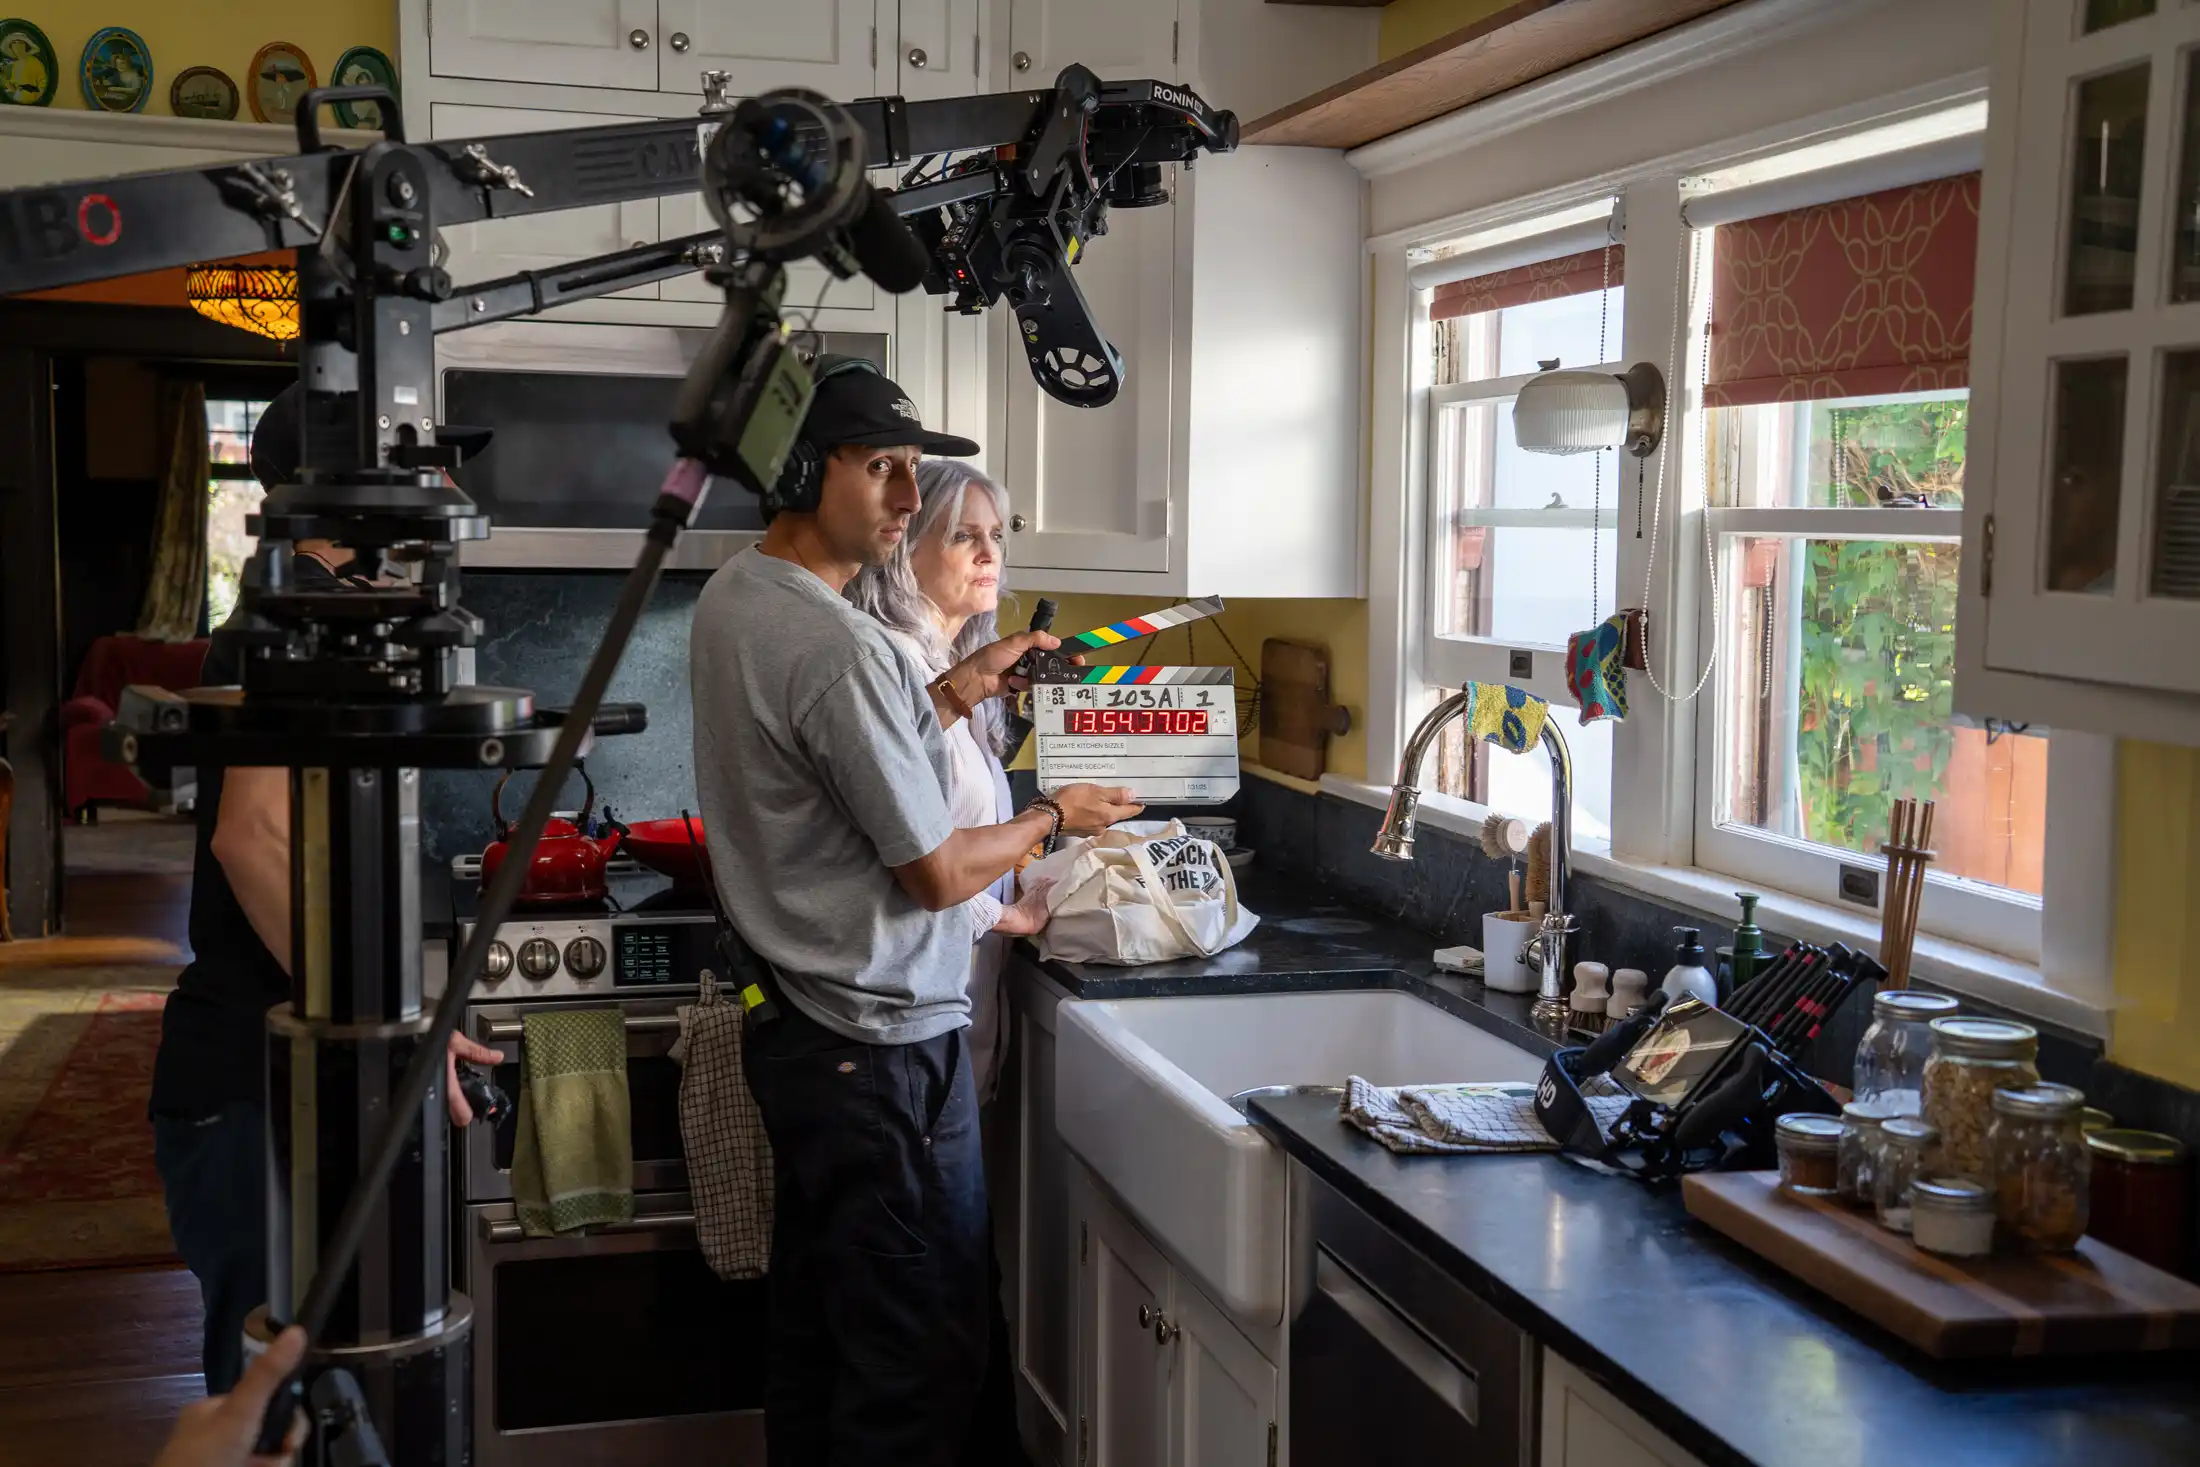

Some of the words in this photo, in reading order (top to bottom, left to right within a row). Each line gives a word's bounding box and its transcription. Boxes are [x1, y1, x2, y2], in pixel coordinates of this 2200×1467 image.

[1154, 85, 1194, 110] RONIN
[0, 193, 122, 264] BO
[1052, 697, 1066, 705] 02
[1076, 688, 1092, 700] 02
[1106, 687, 1173, 709] 103A
[1196, 690, 1215, 708] 1
[1167, 869, 1200, 891] THE
